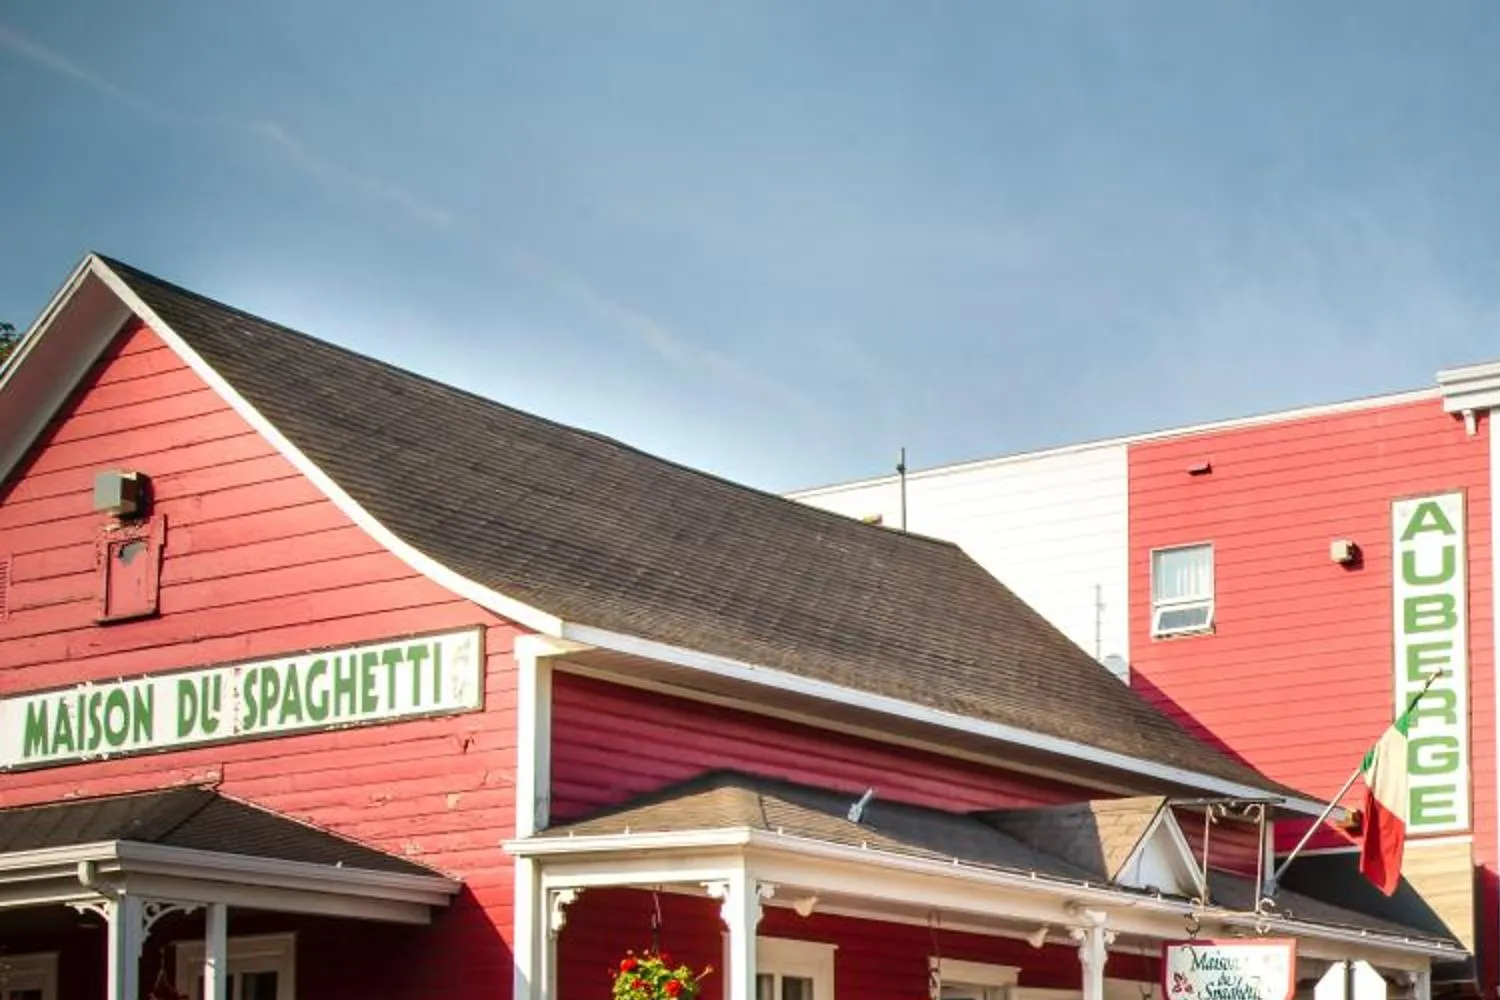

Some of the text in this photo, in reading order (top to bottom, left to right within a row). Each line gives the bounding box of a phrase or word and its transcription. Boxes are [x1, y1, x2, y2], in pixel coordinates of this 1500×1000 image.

[23, 685, 154, 757] MAISON
[177, 674, 222, 738] DU
[242, 643, 442, 730] SPAGHETTI
[1399, 500, 1460, 827] AUBERGE
